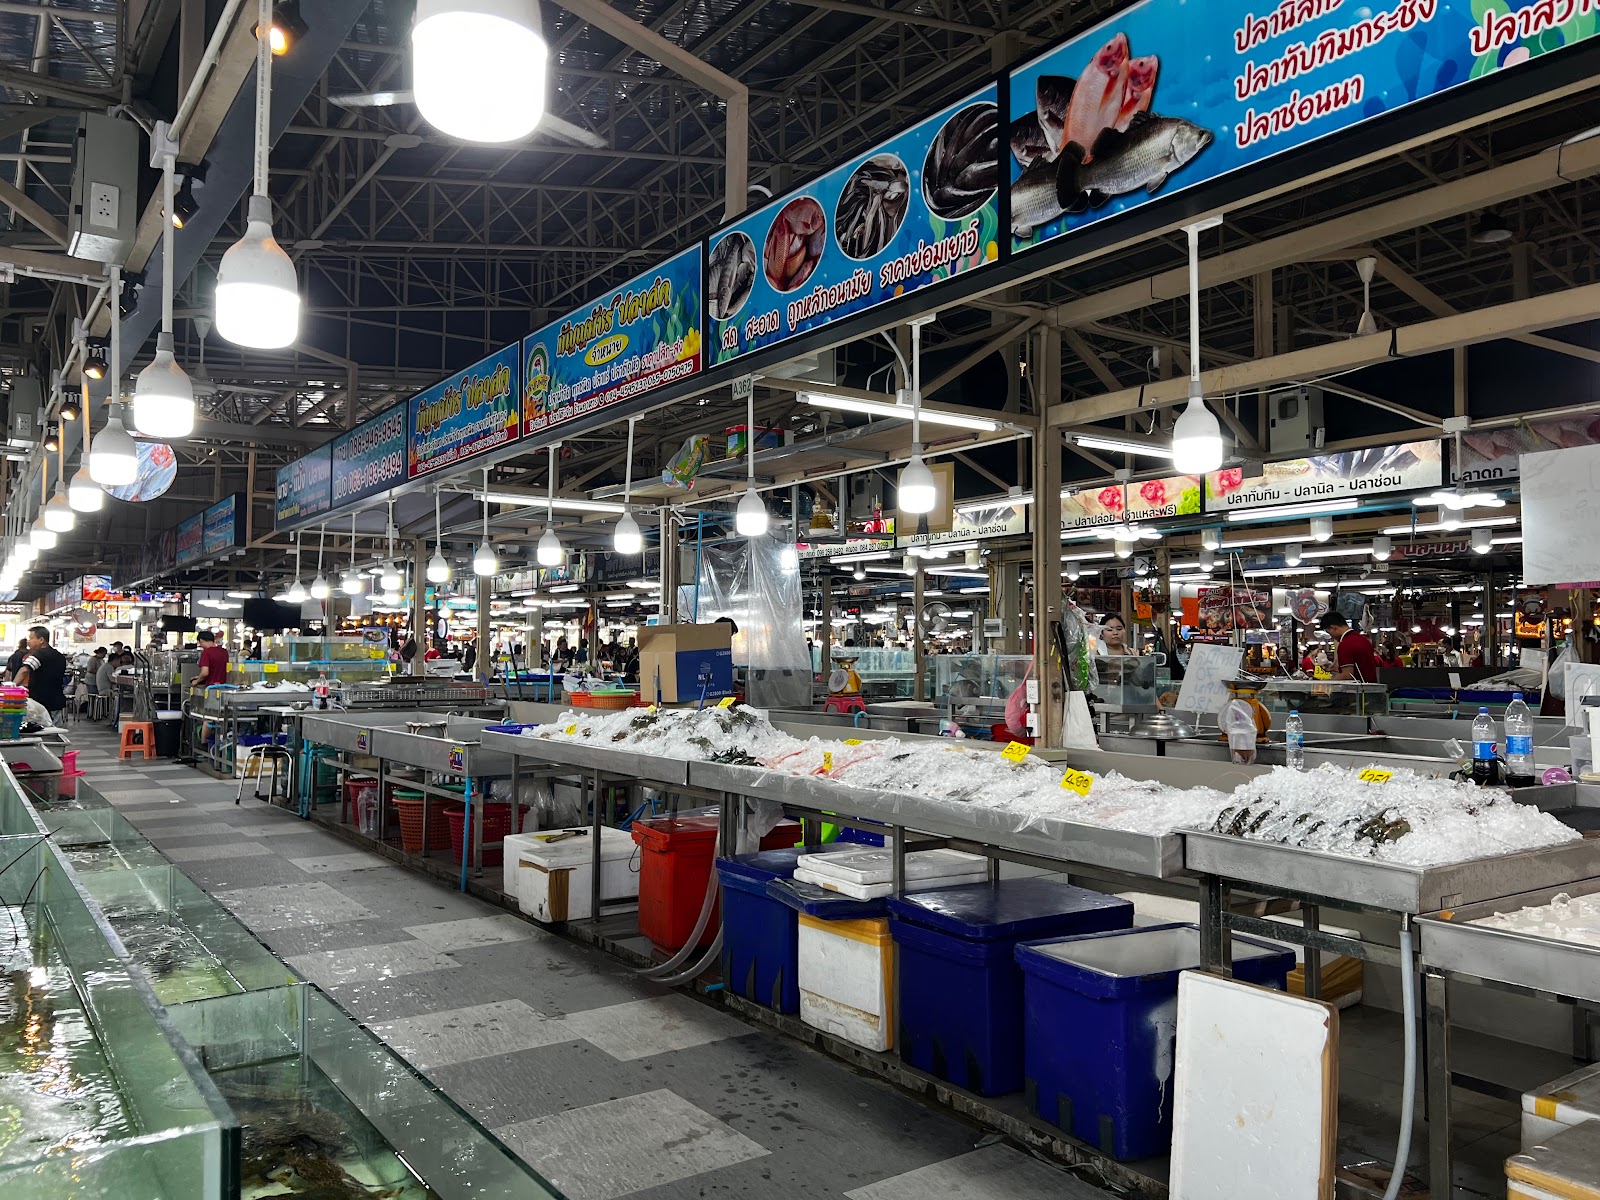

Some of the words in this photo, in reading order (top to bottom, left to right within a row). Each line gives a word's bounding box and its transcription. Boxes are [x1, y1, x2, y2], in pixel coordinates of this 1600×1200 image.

[1236, 76, 1363, 146] ปลาช่อนนา
[745, 309, 780, 341] สะอาด
[787, 269, 873, 333] ถูกหลักอนามัย
[879, 218, 980, 289] ราคาย่อมเยาว์
[591, 336, 623, 364] จำหน่าย
[1227, 488, 1280, 505] ปลาทับทิม
